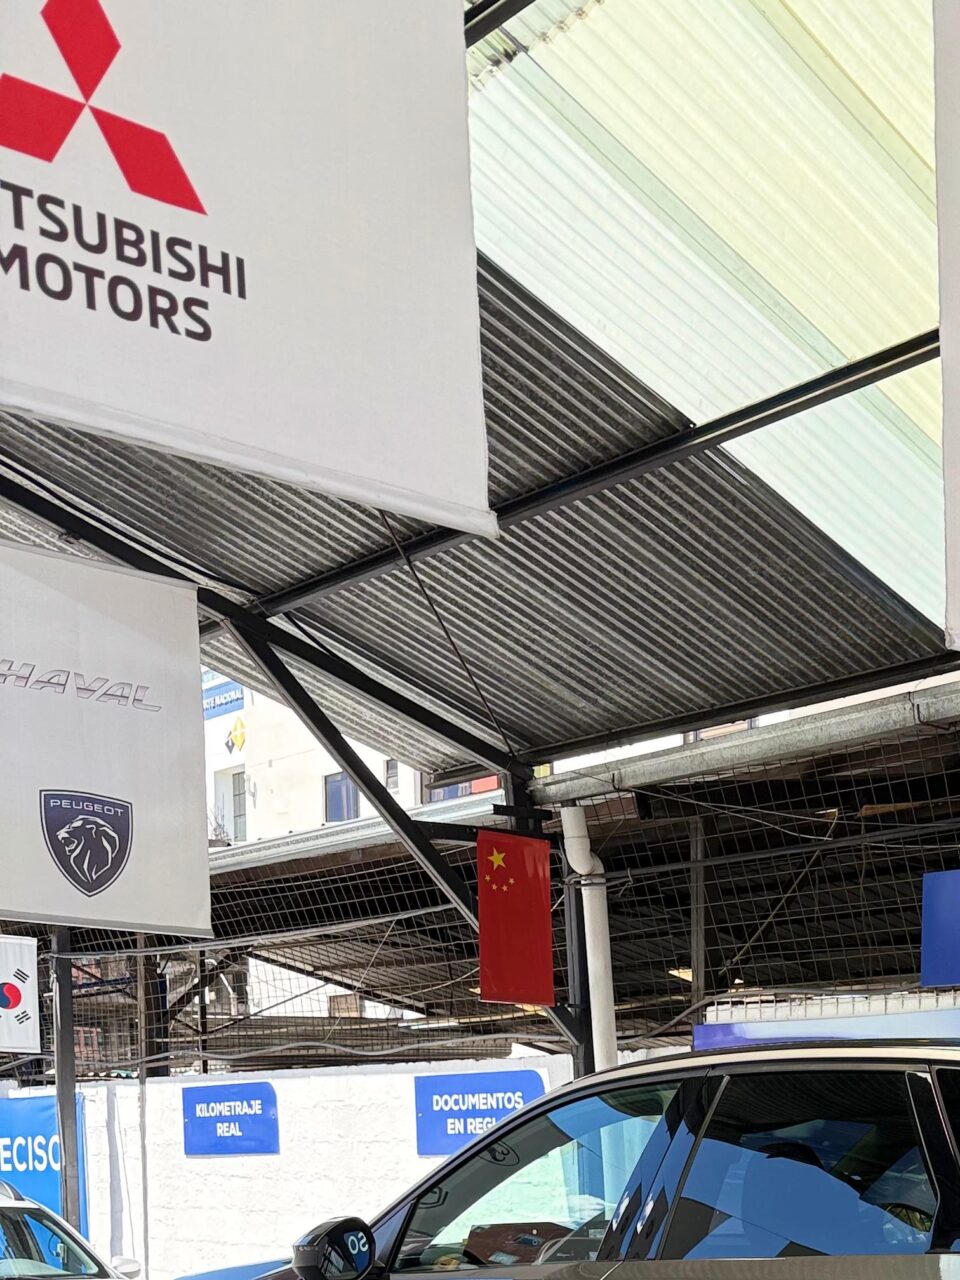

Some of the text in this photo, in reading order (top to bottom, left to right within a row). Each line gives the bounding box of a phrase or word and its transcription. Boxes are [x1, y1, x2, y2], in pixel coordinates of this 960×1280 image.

[0, 658, 162, 713] HAVAL
[49, 799, 125, 817] PEUGEOT
[195, 1099, 263, 1118] KILOMETRAJE
[432, 1091, 524, 1111] DOCUMENTOS
[216, 1121, 243, 1137] REAL
[446, 1116, 507, 1134] EN REG
